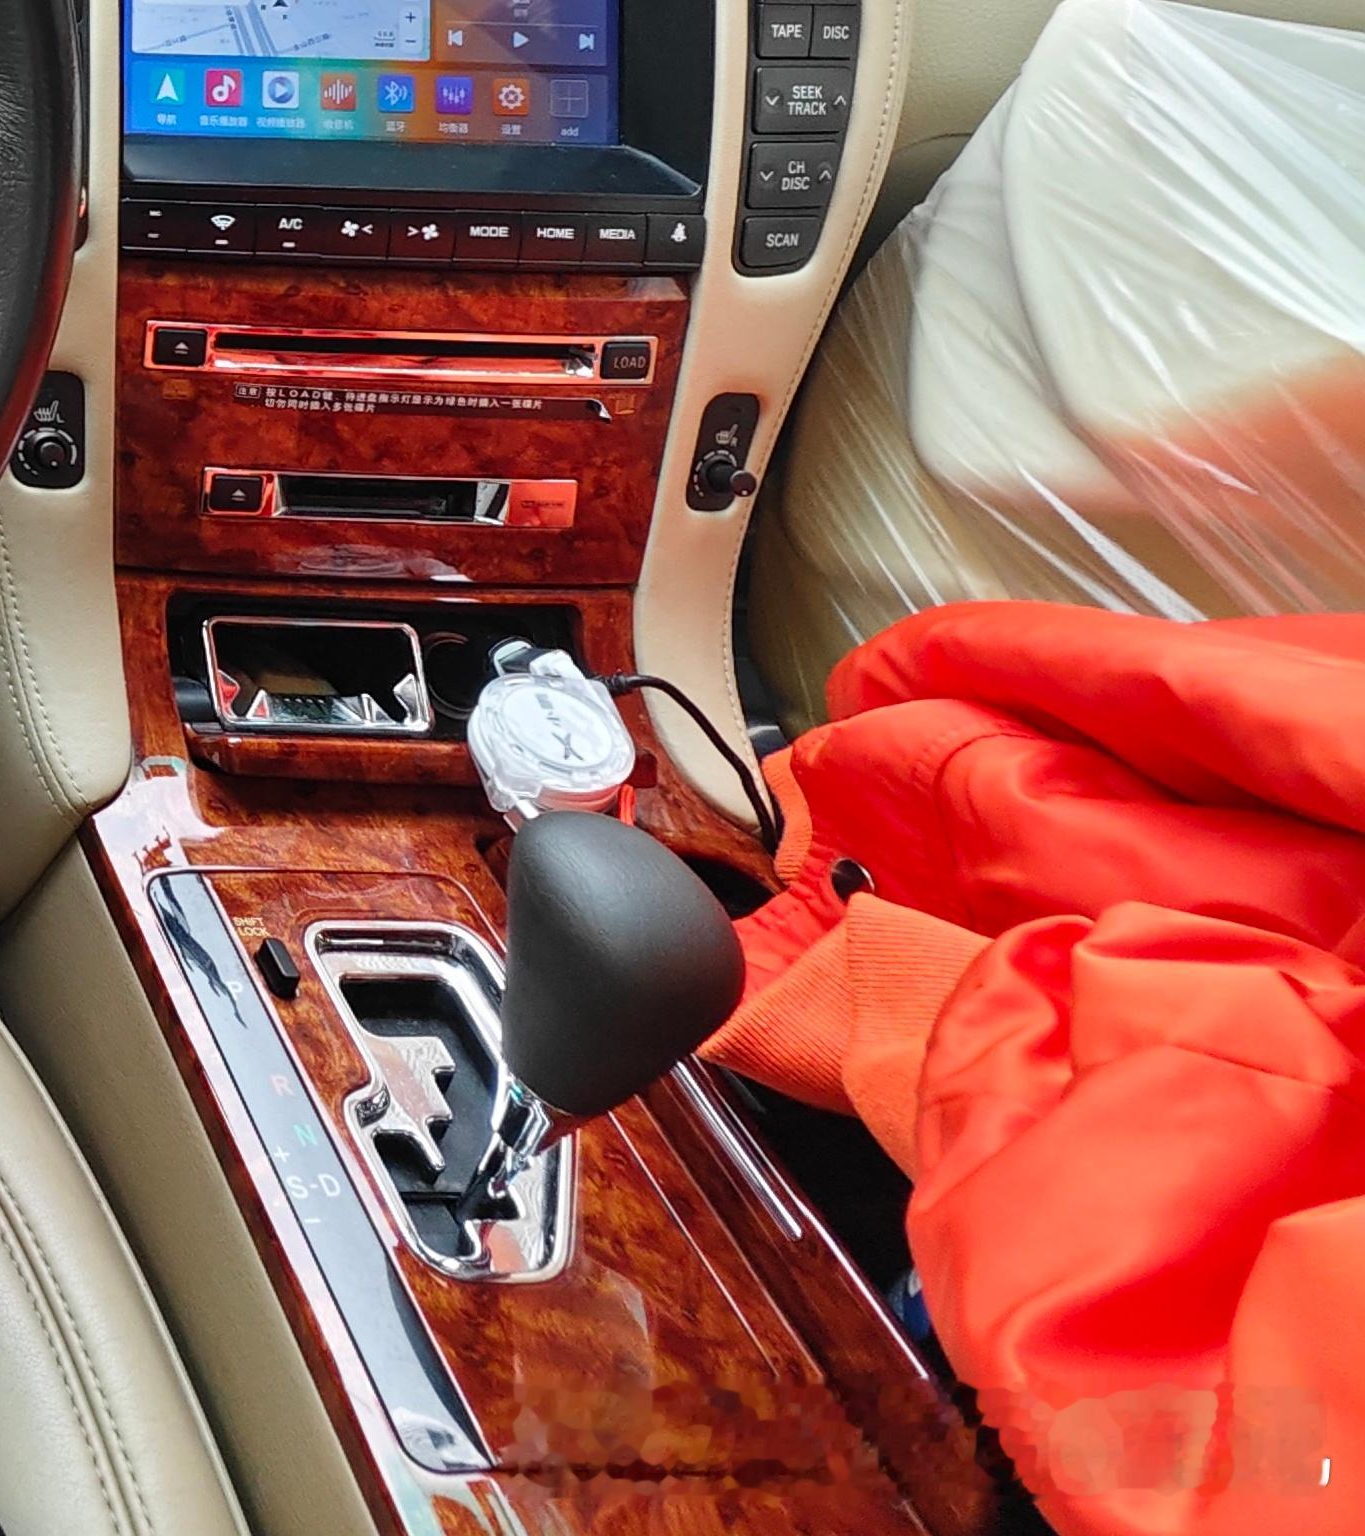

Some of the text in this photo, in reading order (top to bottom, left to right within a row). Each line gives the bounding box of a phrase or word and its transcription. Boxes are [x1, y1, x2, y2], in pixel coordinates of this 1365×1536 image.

[770, 23, 803, 39] TAPE
[822, 24, 850, 40] DISC
[792, 85, 824, 100] SEEK
[787, 101, 827, 116] TRACK
[561, 126, 579, 137] add
[788, 160, 806, 175] CH
[781, 175, 811, 191] DISC
[278, 218, 303, 230] A/C
[470, 226, 509, 238] MODE
[536, 227, 575, 239] HOME
[599, 228, 636, 240] MEDIA
[766, 232, 800, 248] SCAN
[613, 356, 646, 369] LOAD
[232, 916, 264, 927] SHIFT
[237, 926, 271, 937] LOCK
[229, 981, 244, 1001] P
[271, 1075, 295, 1096] R
[292, 1123, 318, 1147] N
